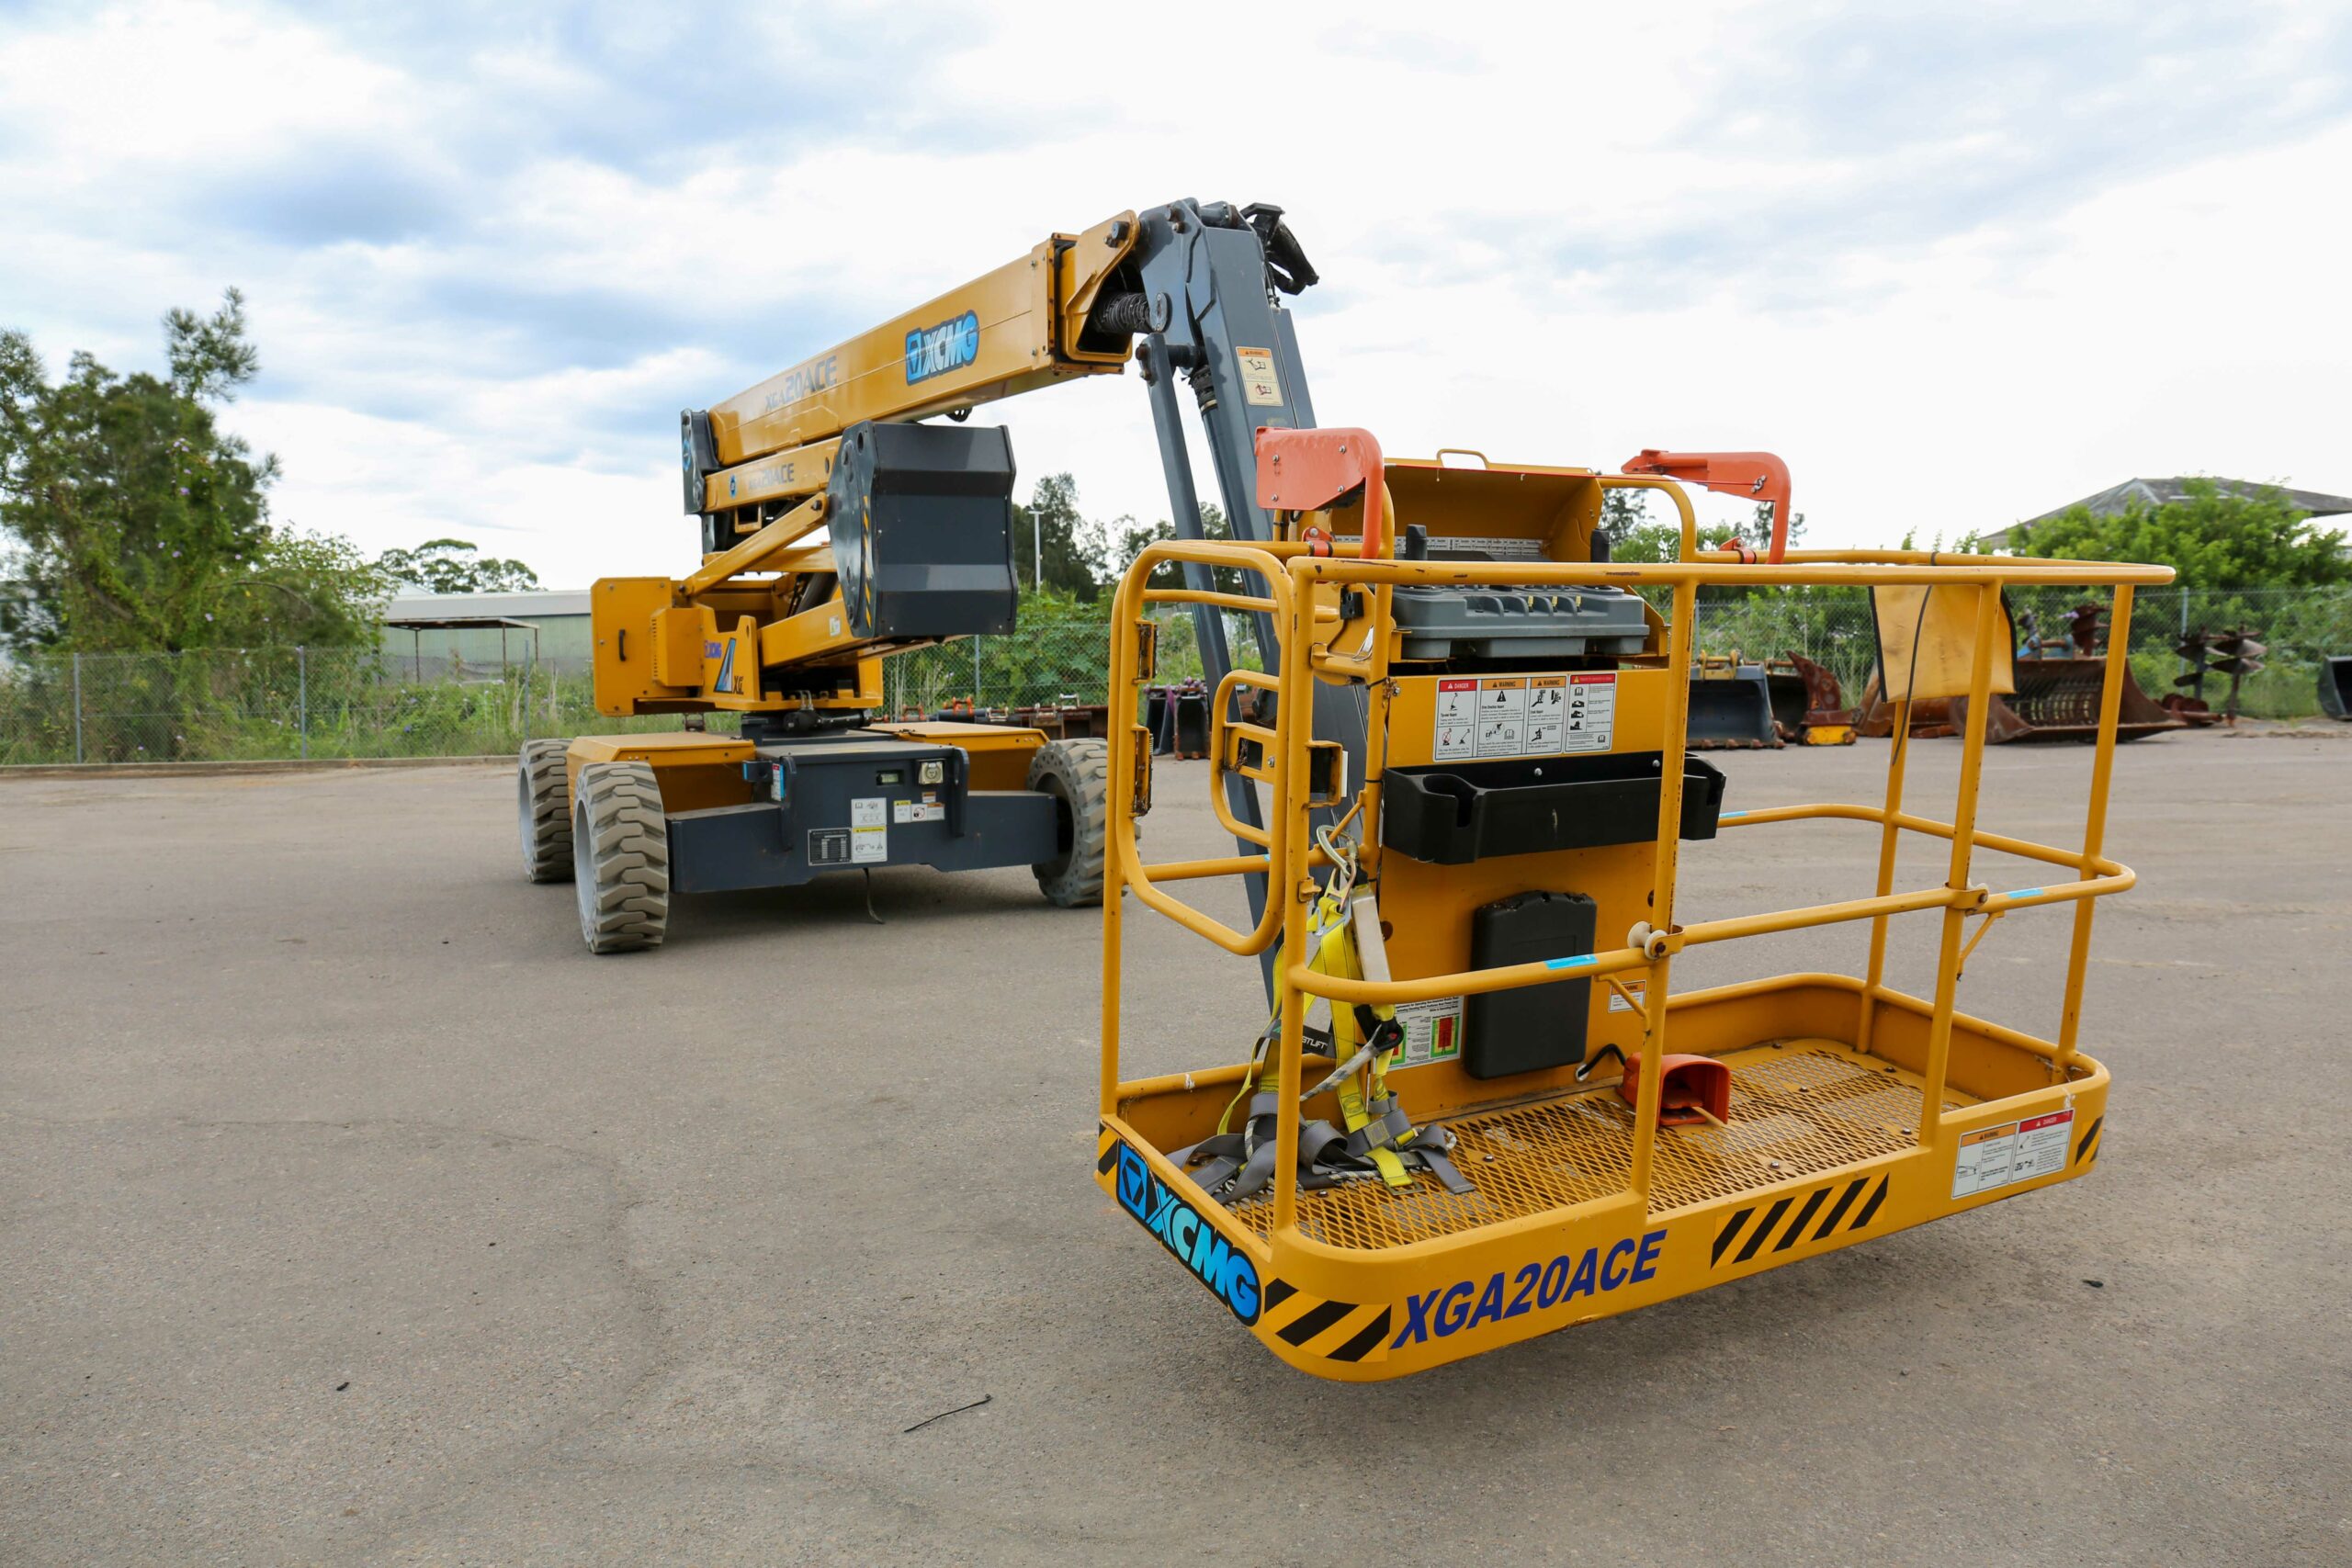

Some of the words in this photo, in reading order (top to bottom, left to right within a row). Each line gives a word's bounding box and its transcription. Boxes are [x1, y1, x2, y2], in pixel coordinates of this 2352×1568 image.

[764, 355, 837, 412] XGA20ACE
[922, 313, 979, 377] XCMG
[1146, 1180, 1260, 1320] XCMG
[1389, 1229, 1668, 1350] XGA20ACE
